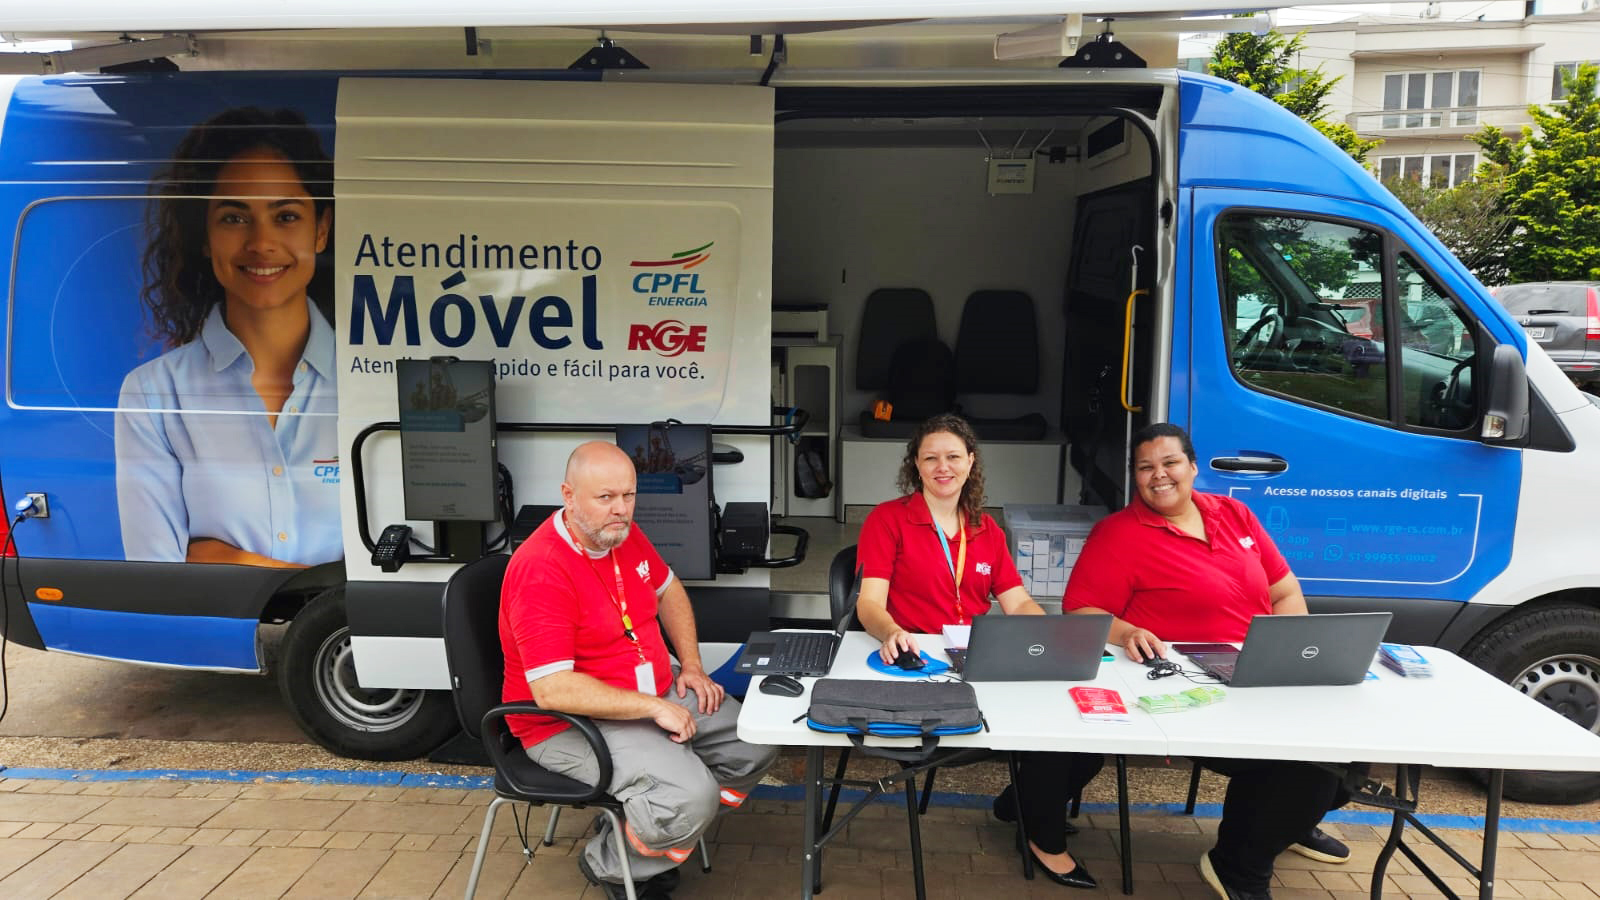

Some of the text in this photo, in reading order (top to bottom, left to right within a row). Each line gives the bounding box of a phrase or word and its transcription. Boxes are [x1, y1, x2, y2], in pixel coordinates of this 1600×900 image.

[354, 234, 602, 271] Atendimento
[632, 272, 706, 294] CPFL
[349, 271, 604, 351] Móvel
[648, 296, 708, 307] ENERGIA
[627, 319, 708, 358] RGE
[494, 358, 705, 381] pido e fácil para você.
[313, 465, 340, 477] CPF
[1264, 486, 1448, 501] Acesse nossos canais digitais
